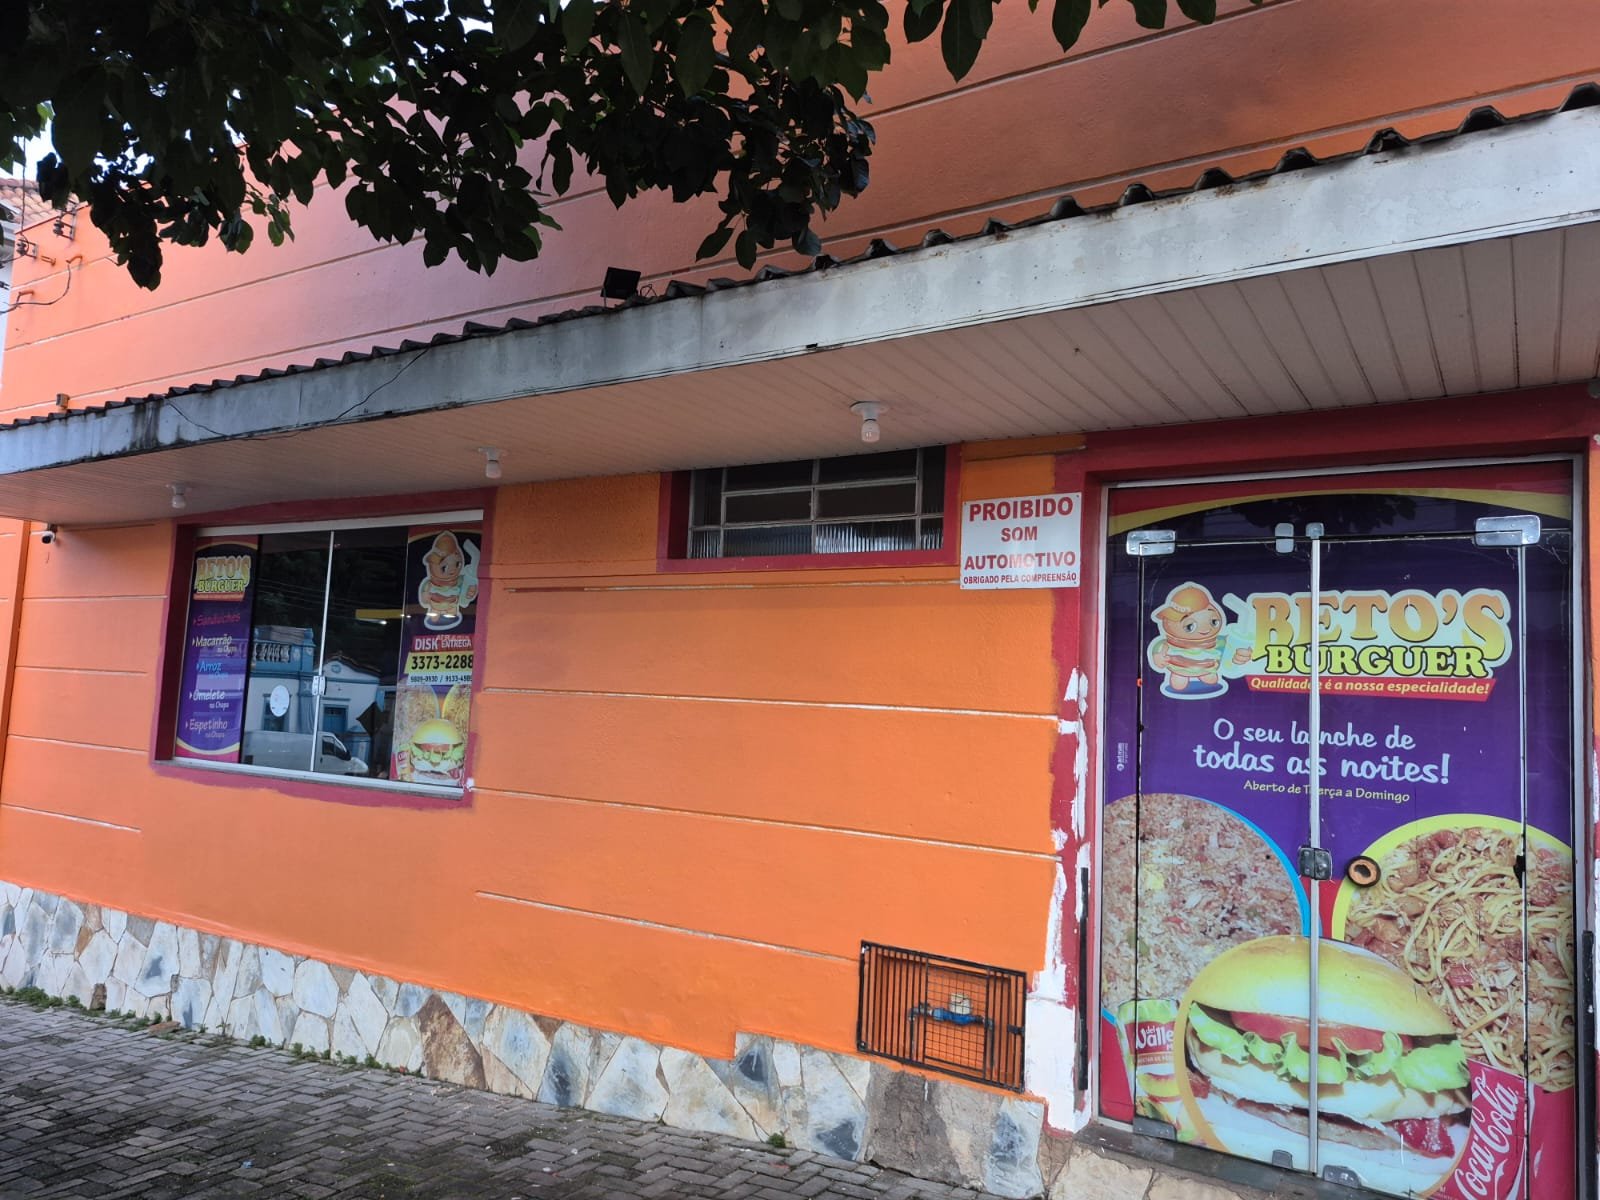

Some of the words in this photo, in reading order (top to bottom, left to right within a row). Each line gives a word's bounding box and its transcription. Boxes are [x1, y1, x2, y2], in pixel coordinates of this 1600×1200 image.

[969, 497, 1073, 522] PROIBIDO
[1001, 526, 1038, 542] SOM
[964, 551, 1076, 570] AUTOMOTIVO
[198, 579, 244, 592] BURGUER
[963, 575, 999, 585] OBRIGADO
[1001, 574, 1019, 583] PELA
[1021, 571, 1077, 583] COMPREENSÃO
[1252, 593, 1506, 662] BETO'S
[195, 633, 233, 647] Macarrão
[414, 637, 438, 650] DISK
[442, 639, 472, 648] ENTREGA
[199, 661, 222, 673] Arroz
[411, 655, 473, 670] 3373-2288
[1265, 645, 1489, 678] BURGUER
[192, 688, 225, 701] Omelete
[1324, 678, 1332, 690] é
[1334, 681, 1343, 691] a
[1345, 682, 1384, 692] nossa
[1386, 680, 1490, 696] especialidade!
[189, 717, 228, 734] Espetinho
[1213, 718, 1234, 740] O
[1243, 727, 1284, 744] seu
[1290, 720, 1377, 748] lanche
[1385, 725, 1416, 750] de
[1193, 741, 1275, 773] todas
[1286, 756, 1328, 776] as
[1340, 752, 1451, 785] noites!
[1243, 780, 1286, 793] Aberto
[1287, 783, 1301, 794] de
[1345, 789, 1353, 798] a
[1355, 787, 1411, 804] Domingo
[1146, 1025, 1156, 1033] del
